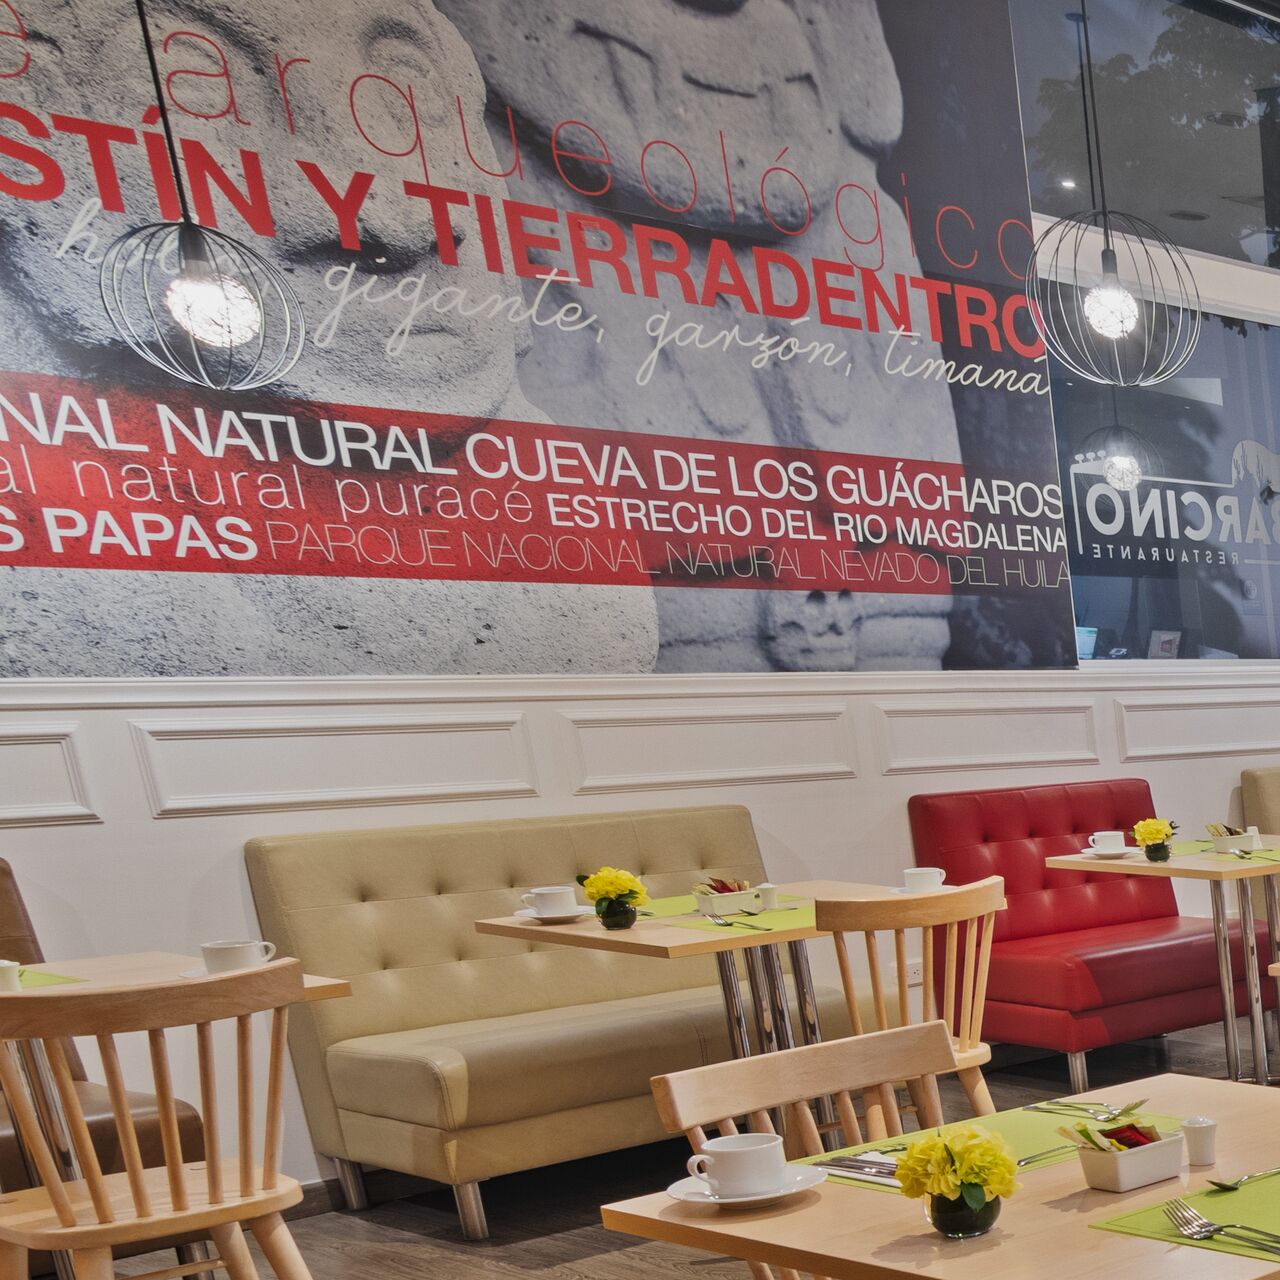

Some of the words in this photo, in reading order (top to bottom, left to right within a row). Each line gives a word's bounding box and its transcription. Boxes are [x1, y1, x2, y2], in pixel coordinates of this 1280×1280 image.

[296, 160, 376, 251] Y
[403, 181, 1047, 359] TIERRADENTRO
[314, 257, 604, 356] gigante,
[636, 310, 854, 386] garzón,
[884, 324, 1051, 396] timaná
[72, 457, 305, 510] natural
[335, 480, 532, 523] puracé
[546, 493, 752, 537] ESTRECHO
[761, 508, 827, 541] DEL
[833, 512, 888, 544] RIO
[895, 516, 1068, 553] MAGDALENA
[156, 404, 458, 475] NATURAL
[466, 433, 647, 489] CUEVA
[653, 449, 721, 494] DE
[728, 456, 818, 502] LOS
[826, 462, 1064, 519] GUÁCHAROS
[41, 507, 259, 561] PAPAS
[266, 522, 456, 566] PARQUE
[462, 531, 661, 574] NACIONAL
[666, 541, 816, 579] NATURAL
[821, 549, 940, 584] NEVADO
[946, 555, 999, 586] DEL
[1003, 558, 1071, 588] HUILA
